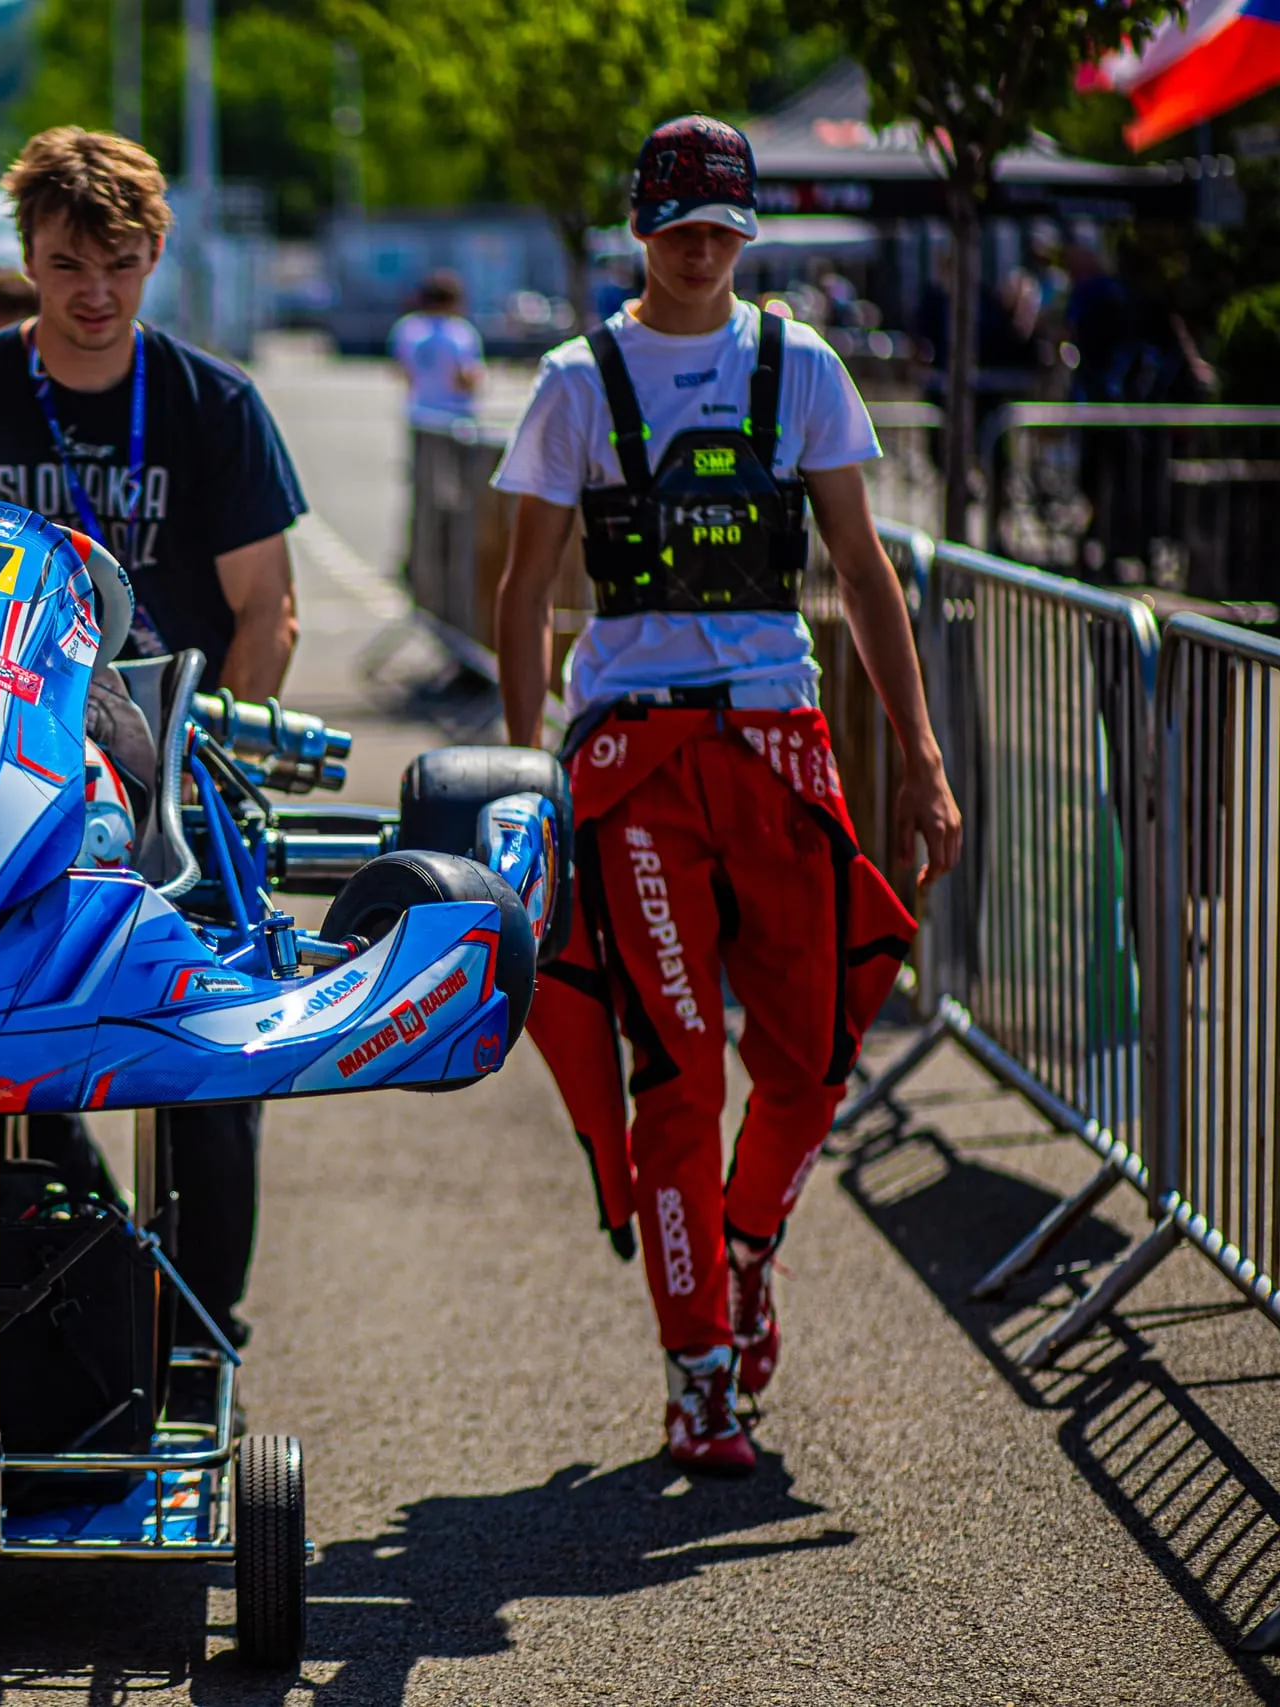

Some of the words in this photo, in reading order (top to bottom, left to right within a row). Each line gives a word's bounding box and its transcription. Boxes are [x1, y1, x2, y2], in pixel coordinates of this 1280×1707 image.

[694, 452, 736, 472] OMP
[692, 525, 741, 544] PRO
[625, 825, 705, 1034] #REDPlayer
[336, 1024, 399, 1079] MAXXIS
[419, 967, 469, 1018] RACING
[657, 1187, 695, 1297] sparco
